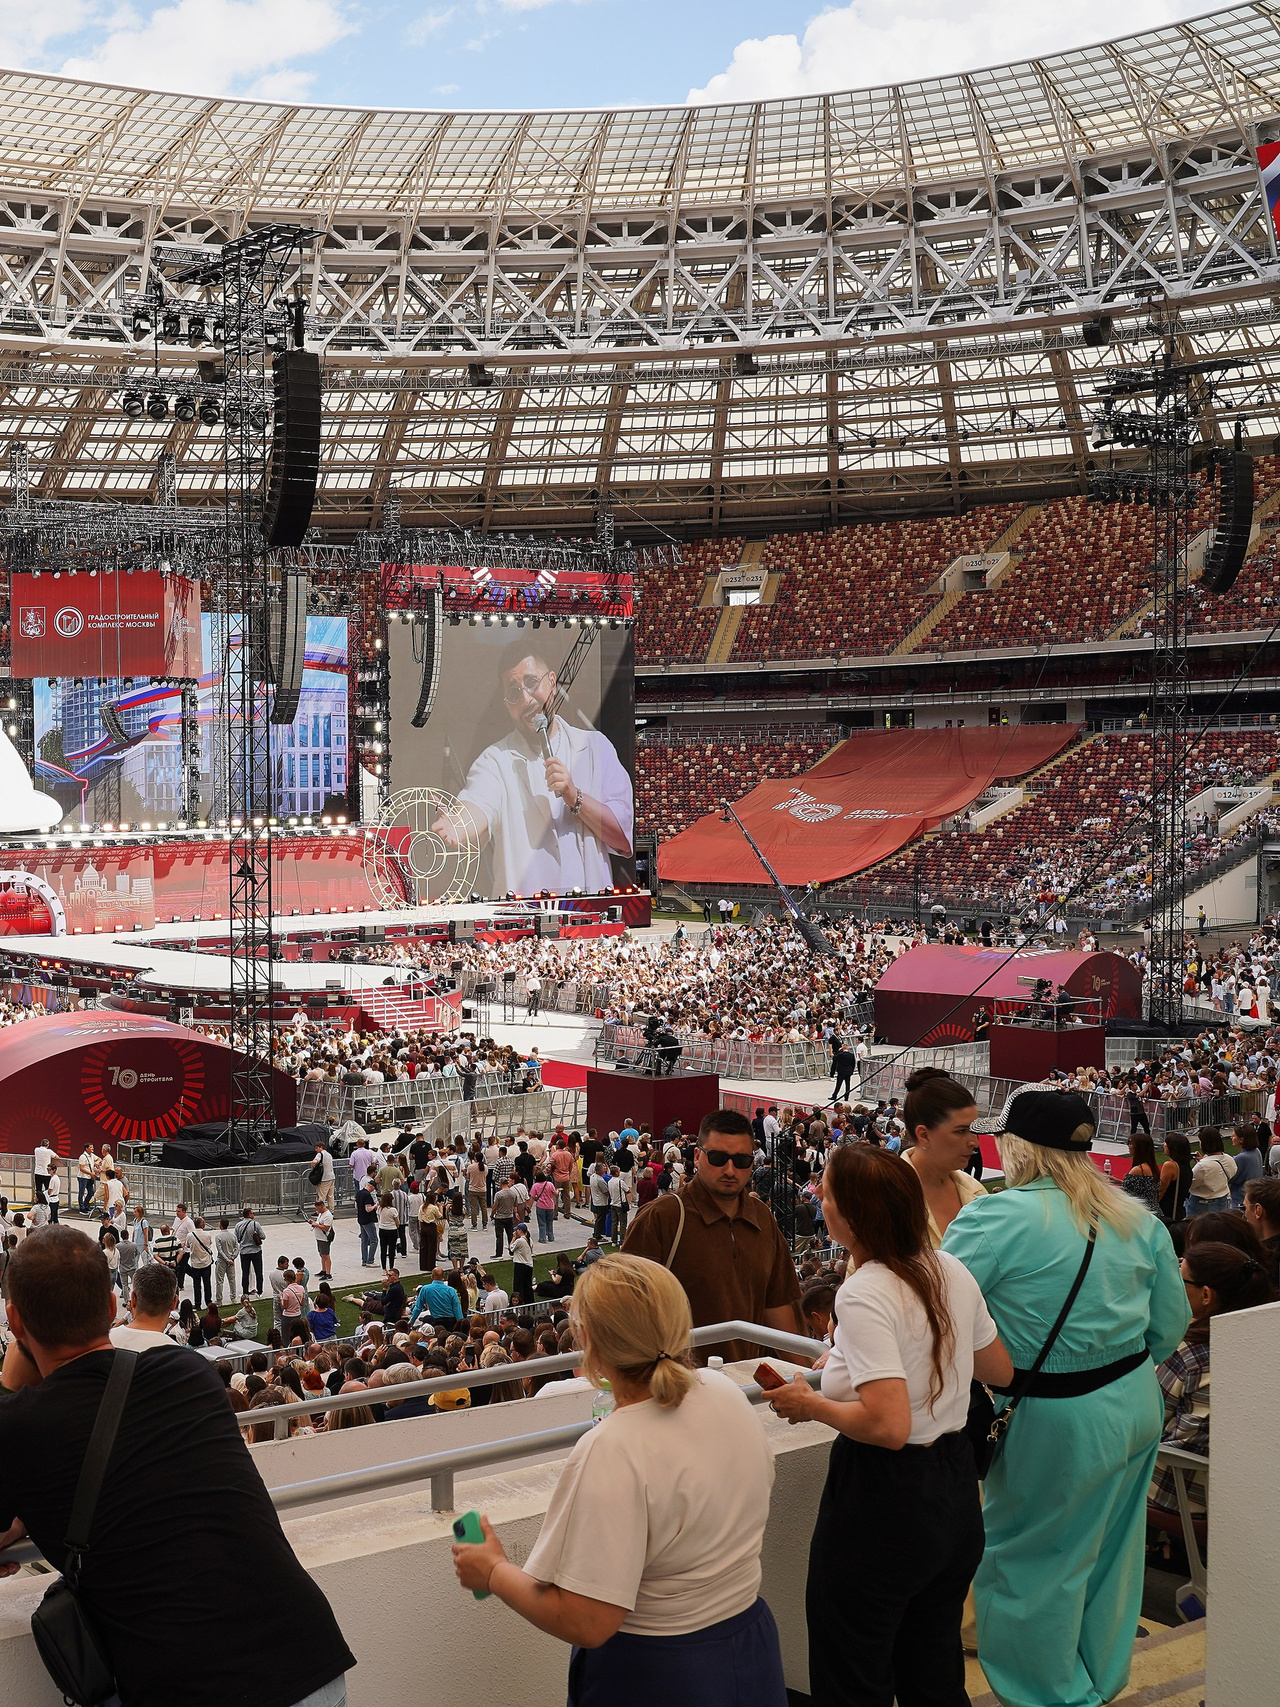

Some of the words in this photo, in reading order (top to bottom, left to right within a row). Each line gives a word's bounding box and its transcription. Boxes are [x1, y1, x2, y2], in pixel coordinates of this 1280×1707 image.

[87, 612, 160, 621] ГРАДОСТРОИТЕЛЬНЫЙ
[87, 621, 125, 629] КОМПЛЕКС
[107, 1066, 138, 1089] 70
